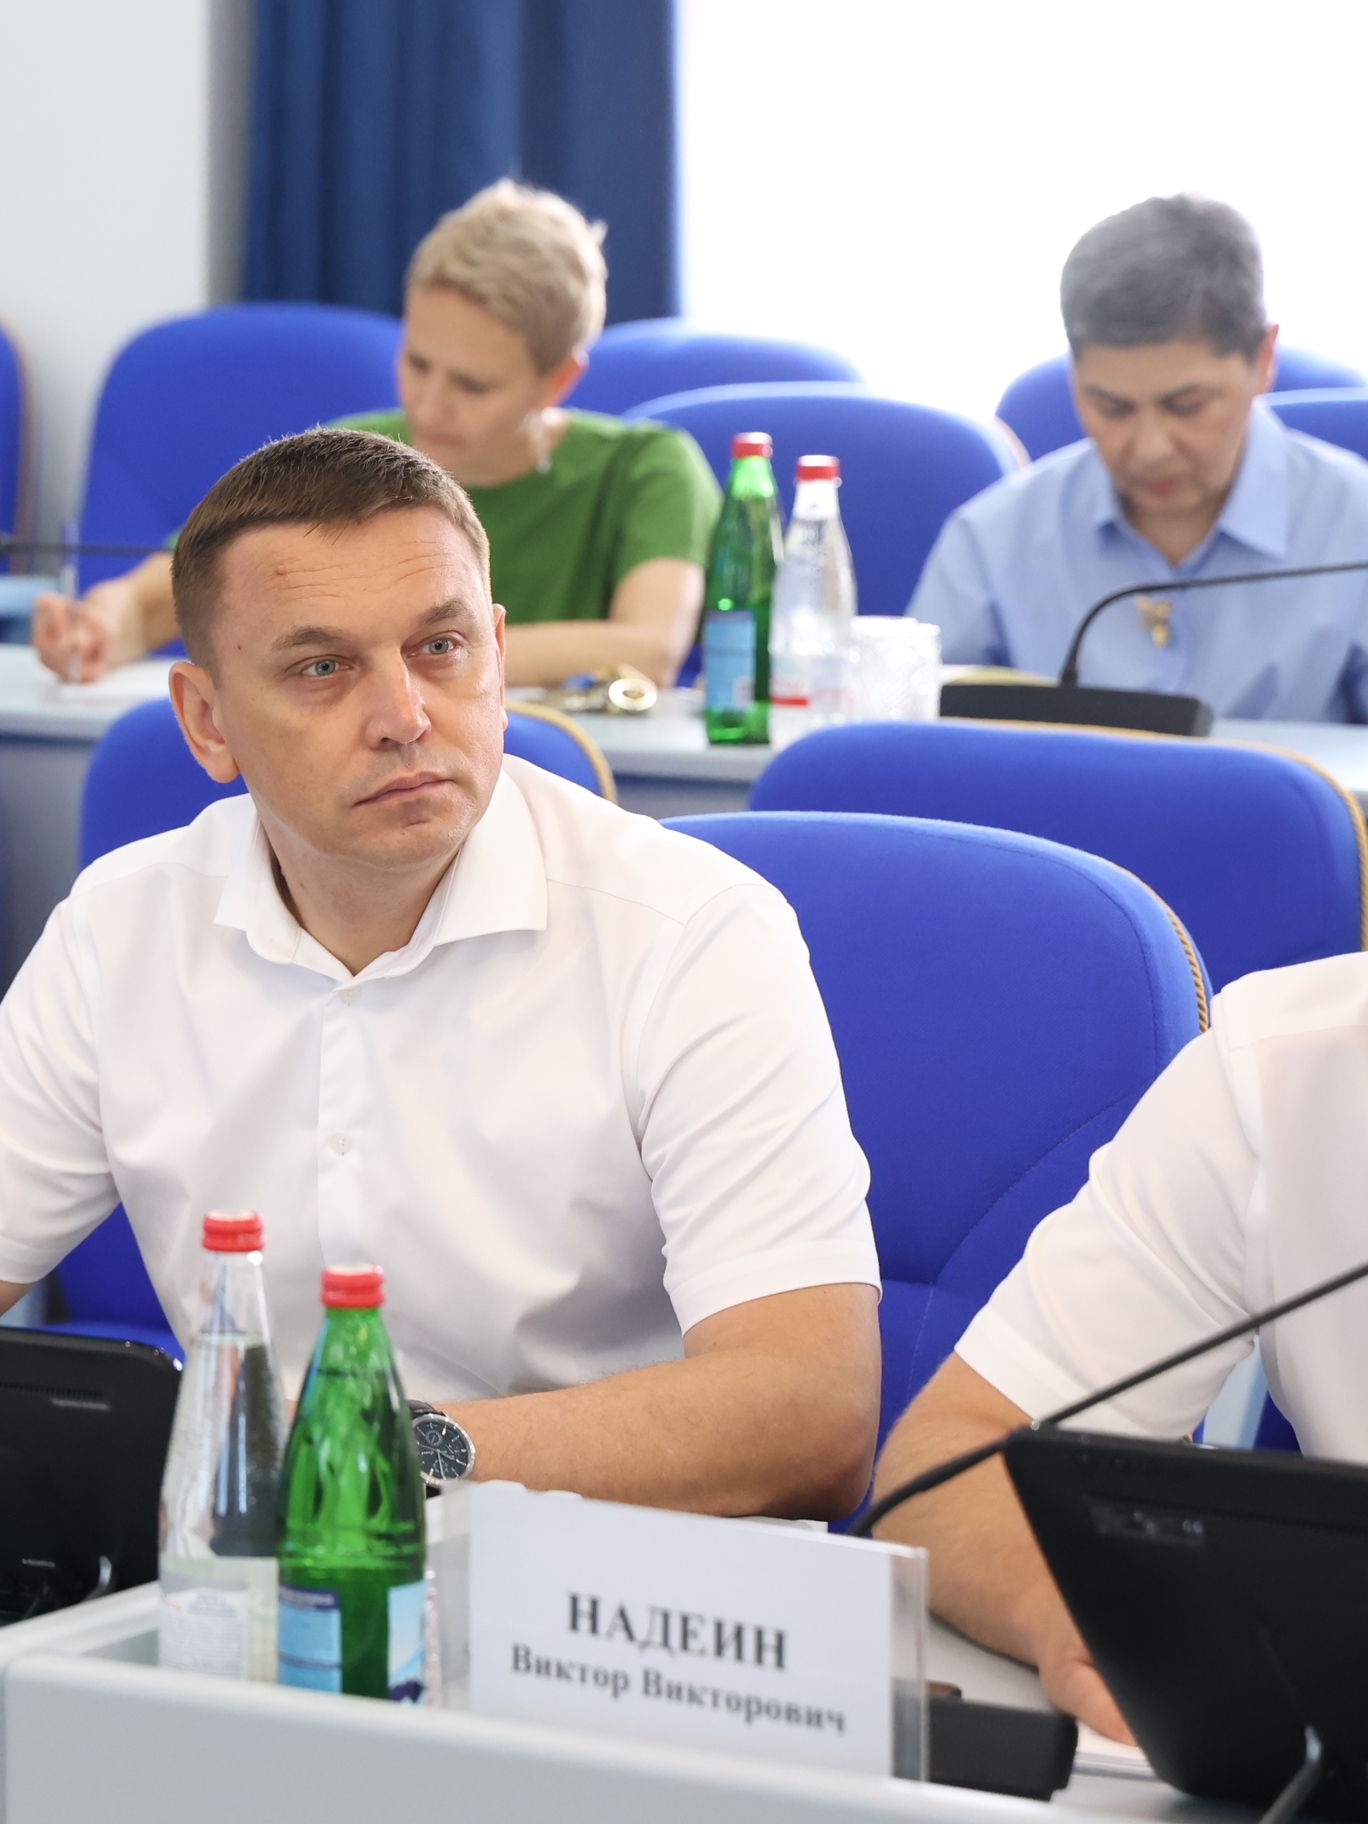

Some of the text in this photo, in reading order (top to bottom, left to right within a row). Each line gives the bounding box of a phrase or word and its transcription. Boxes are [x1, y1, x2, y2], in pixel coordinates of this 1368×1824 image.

[569, 1592, 786, 1669] НАДЕИН
[511, 1642, 846, 1732] Виктор Викторович
